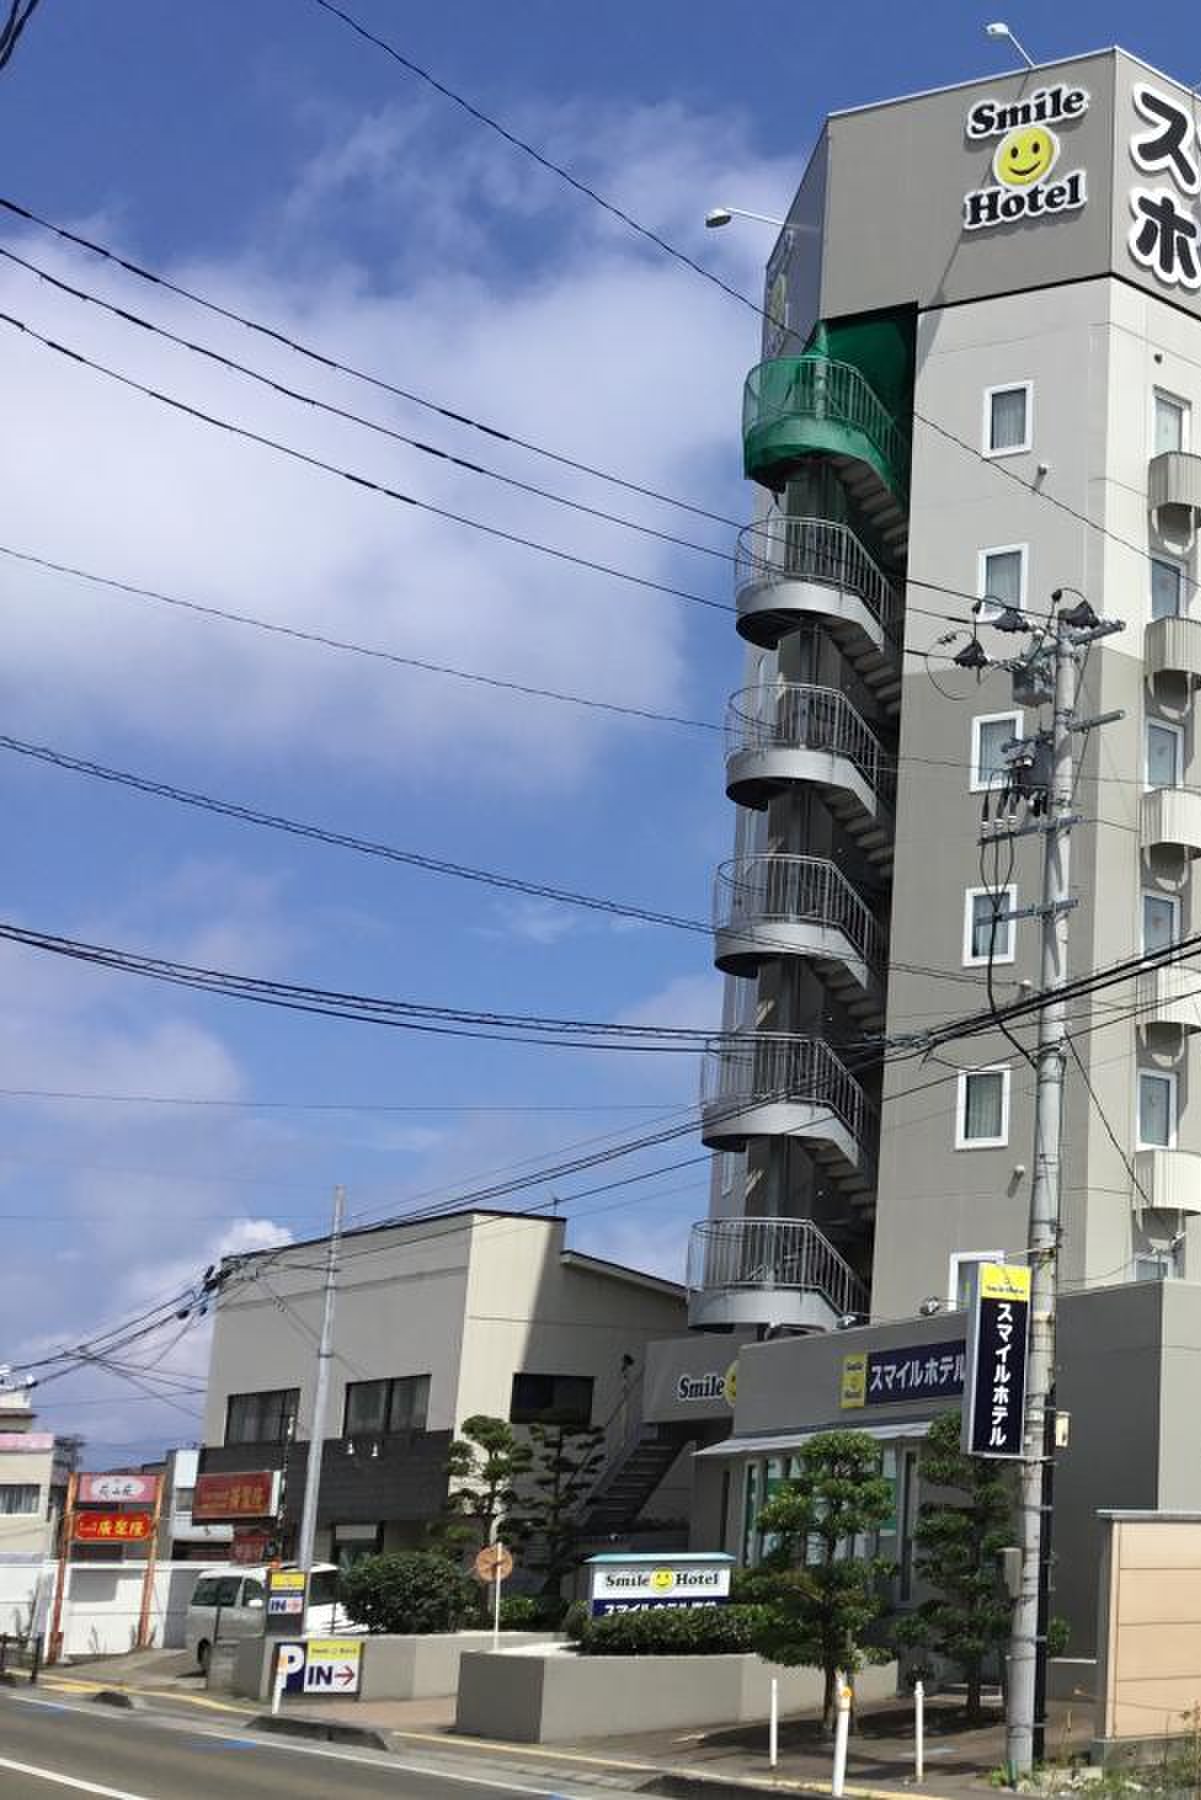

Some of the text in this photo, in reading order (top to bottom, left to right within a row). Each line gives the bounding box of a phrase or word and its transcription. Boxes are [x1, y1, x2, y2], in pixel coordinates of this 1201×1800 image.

[968, 87, 1086, 137] Smile
[966, 173, 1084, 228] Hotel
[679, 1375, 726, 1399] Smile
[869, 1353, 966, 1393] スマイルホテル
[988, 1303, 1013, 1447] スマイルホテル
[606, 1572, 719, 1588] Smile Hotel
[271, 1599, 287, 1612] IN
[278, 1645, 333, 1688] P IN
